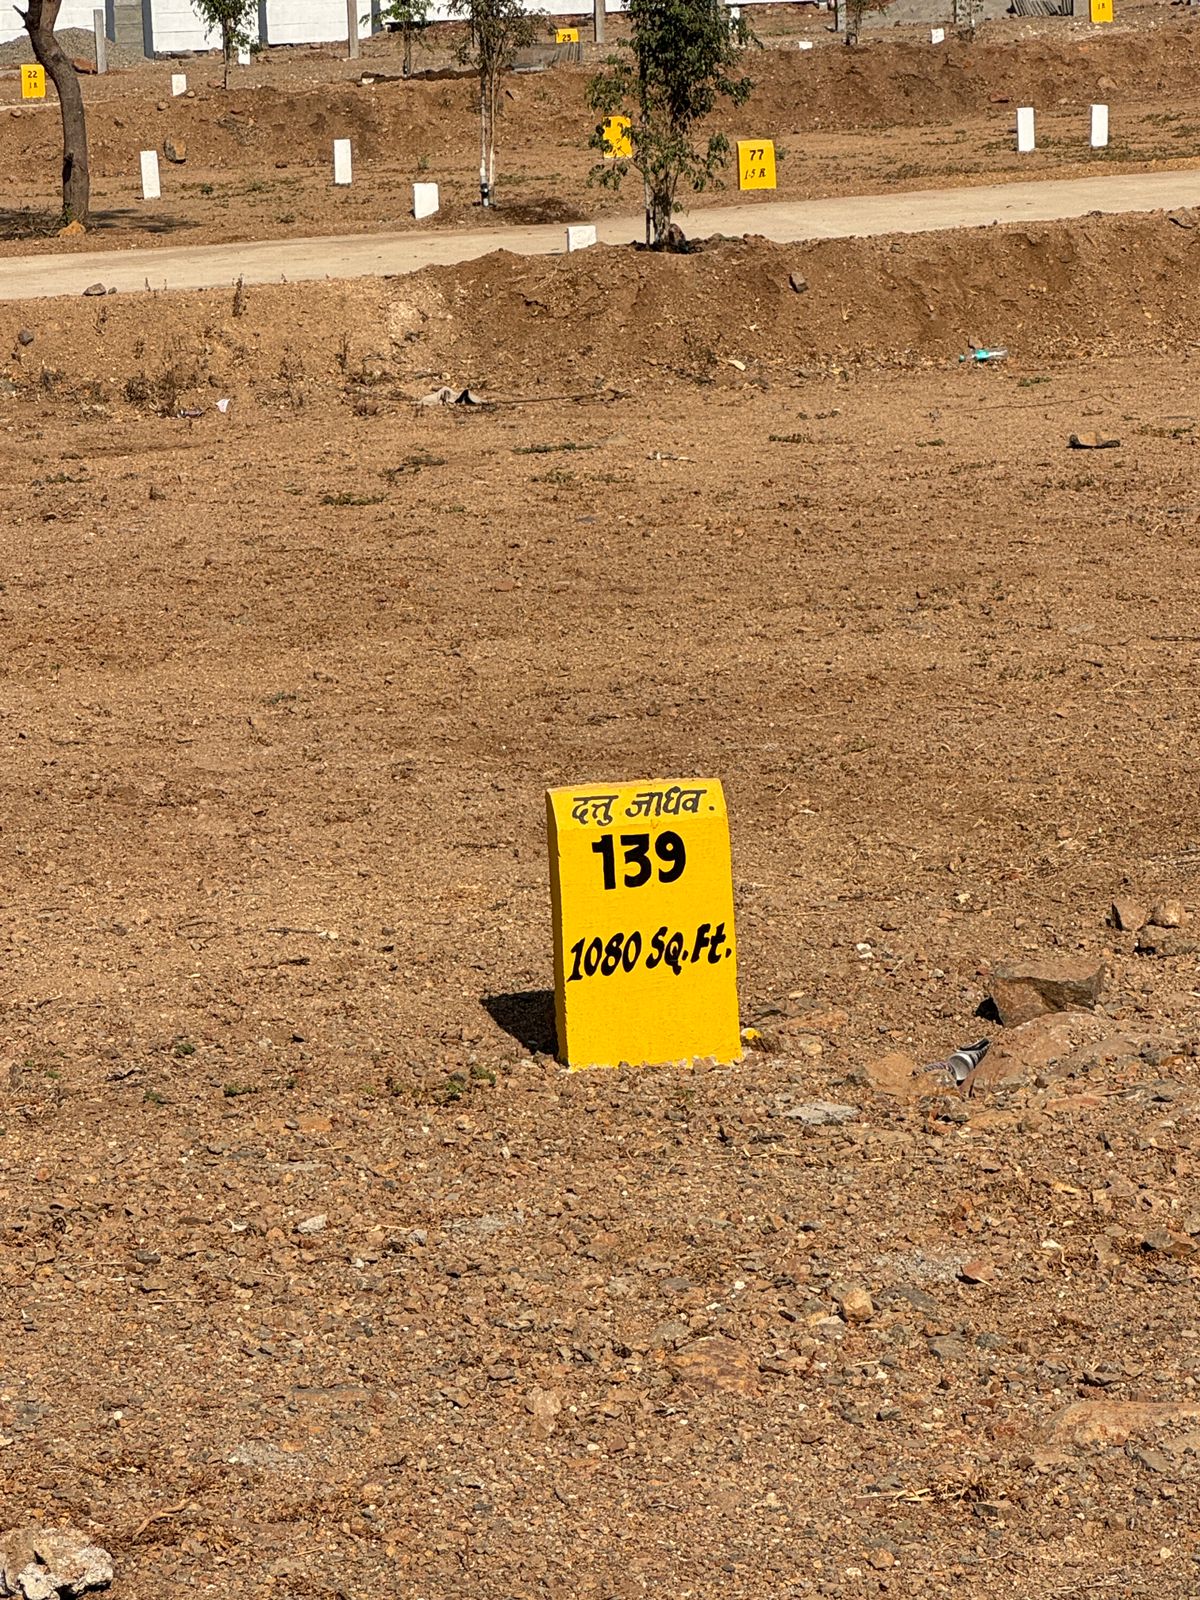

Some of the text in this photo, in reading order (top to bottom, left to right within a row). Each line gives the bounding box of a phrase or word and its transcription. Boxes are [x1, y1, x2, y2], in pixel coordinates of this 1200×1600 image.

[27, 70, 38, 79] 22
[749, 149, 764, 161] 77
[591, 830, 687, 891] 139
[566, 930, 642, 983] 1080
